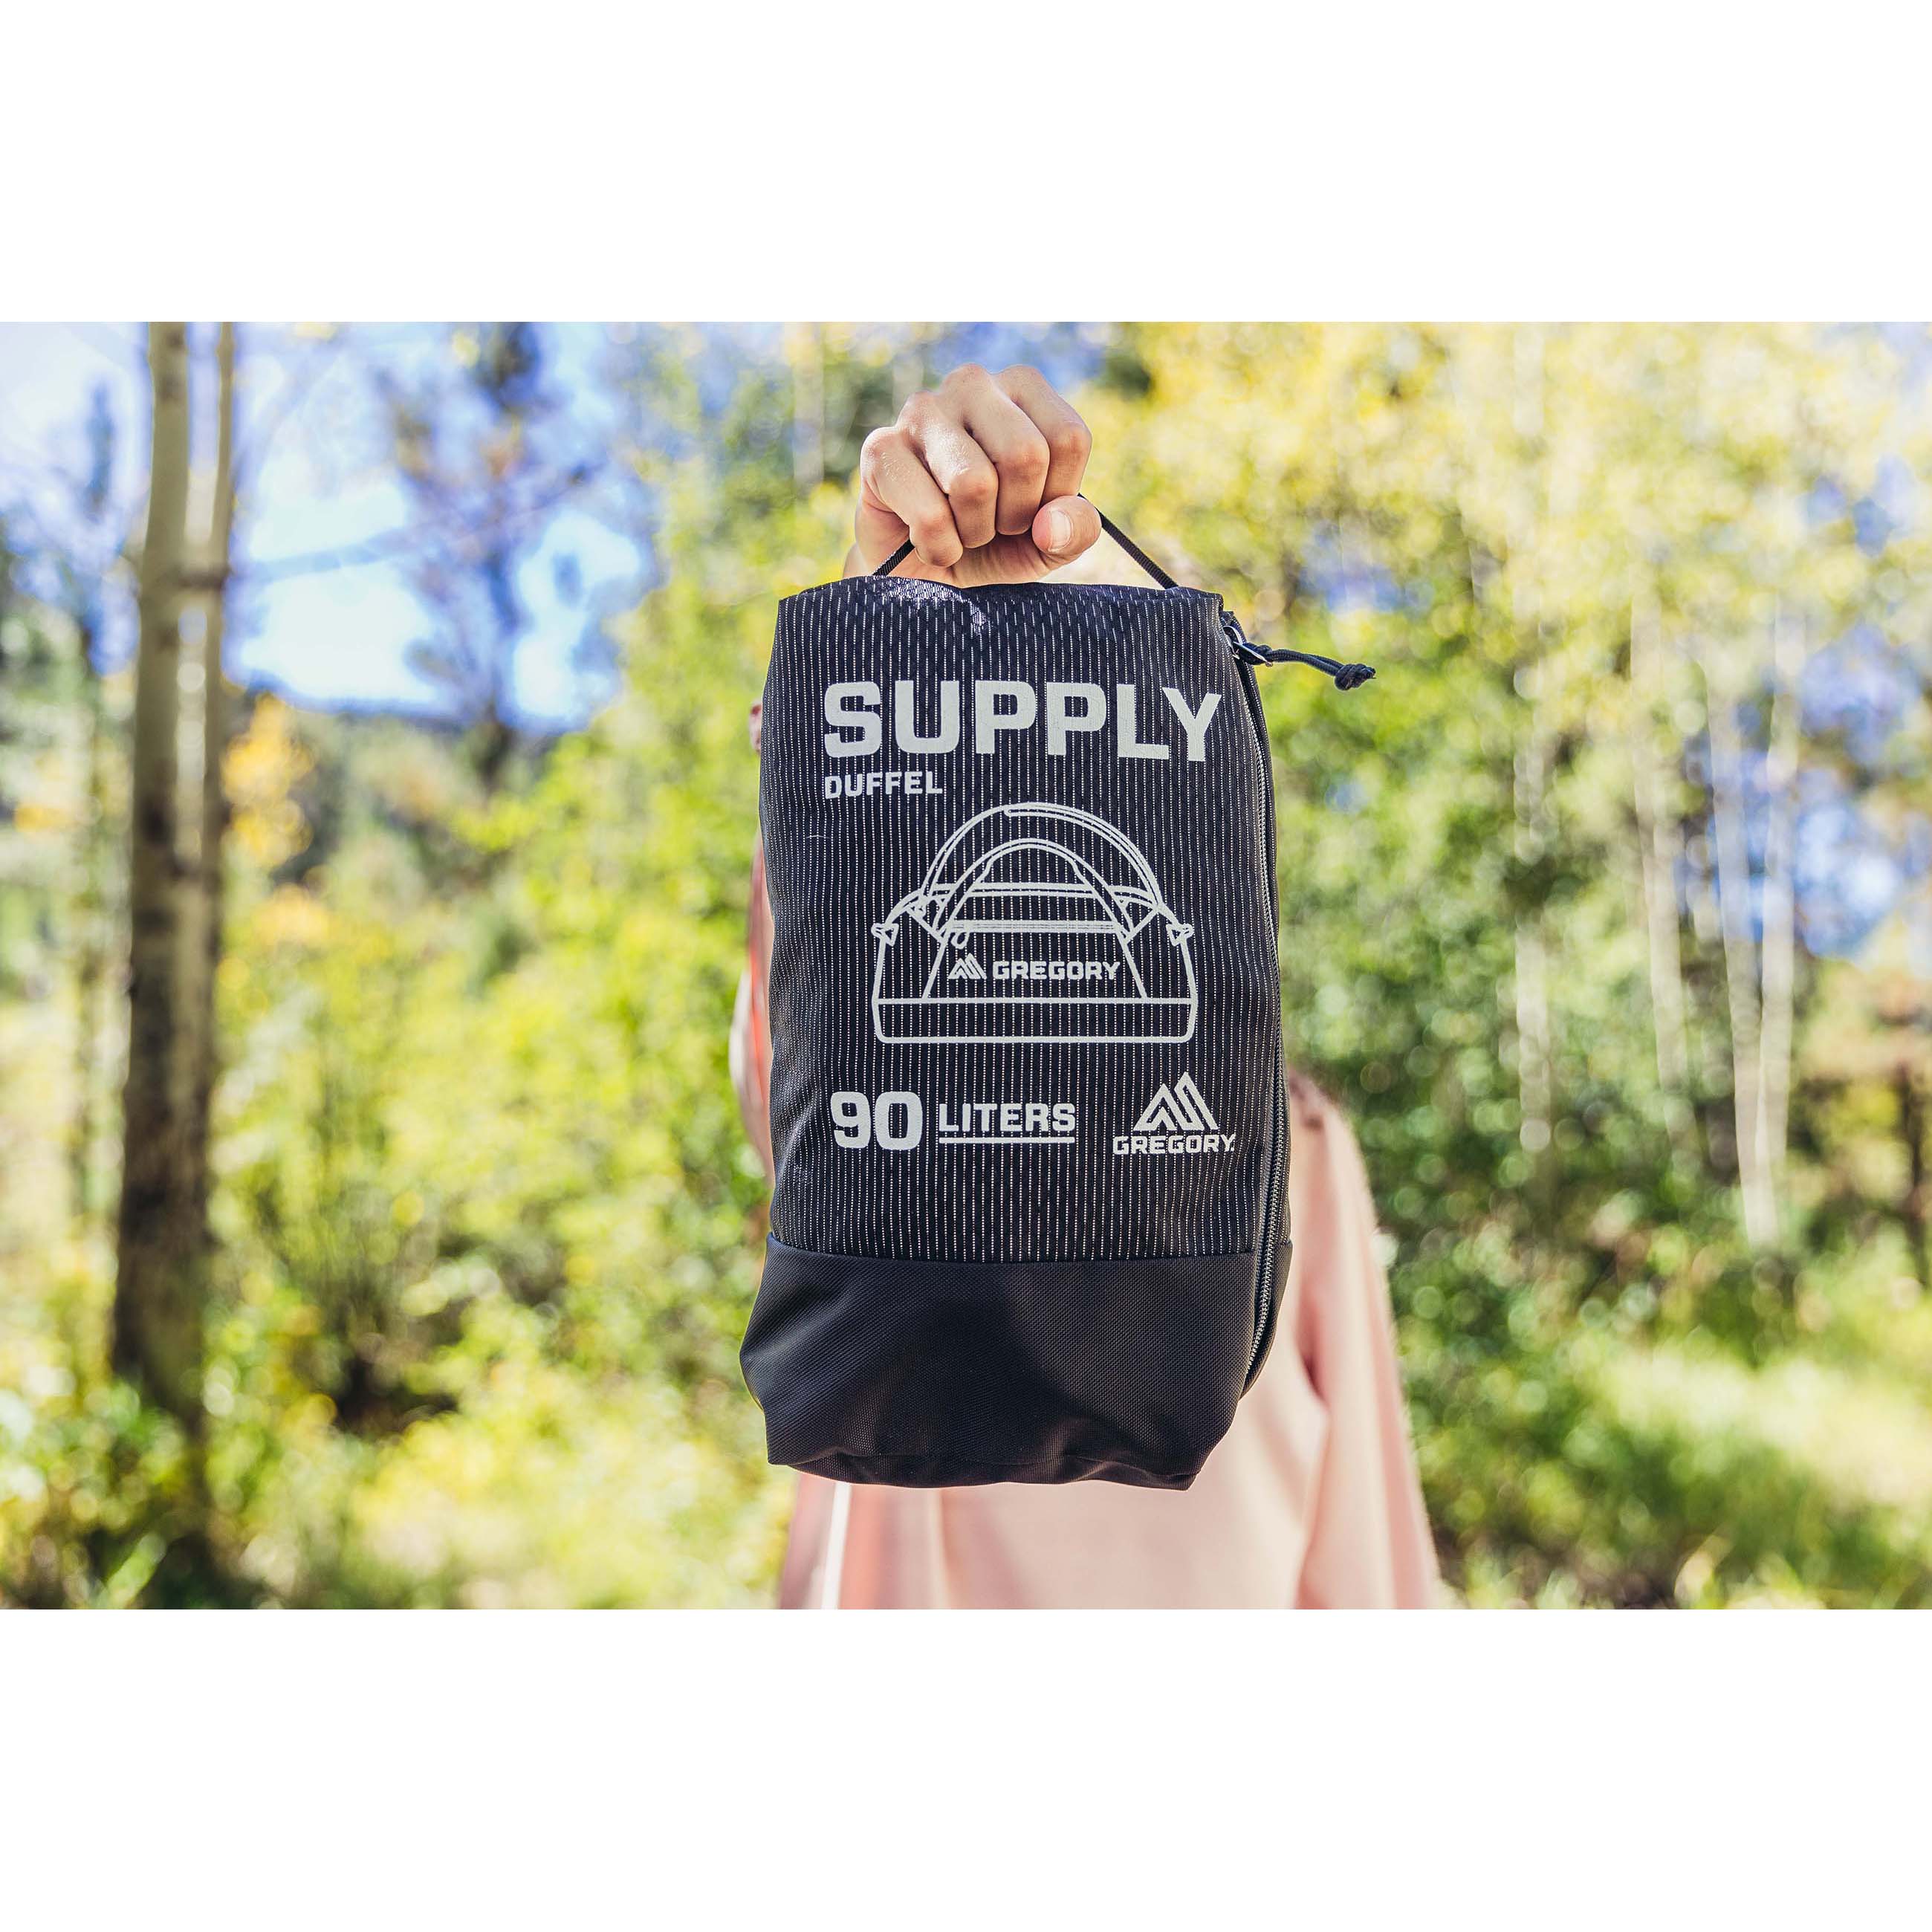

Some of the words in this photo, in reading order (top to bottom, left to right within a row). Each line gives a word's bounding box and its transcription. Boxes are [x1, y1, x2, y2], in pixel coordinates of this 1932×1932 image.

[824, 680, 1222, 762] SUPPLY
[825, 771, 942, 799] DUFFEL
[993, 960, 1121, 980] GREGORY
[830, 1092, 923, 1150] 90
[939, 1103, 1075, 1133] LITERS
